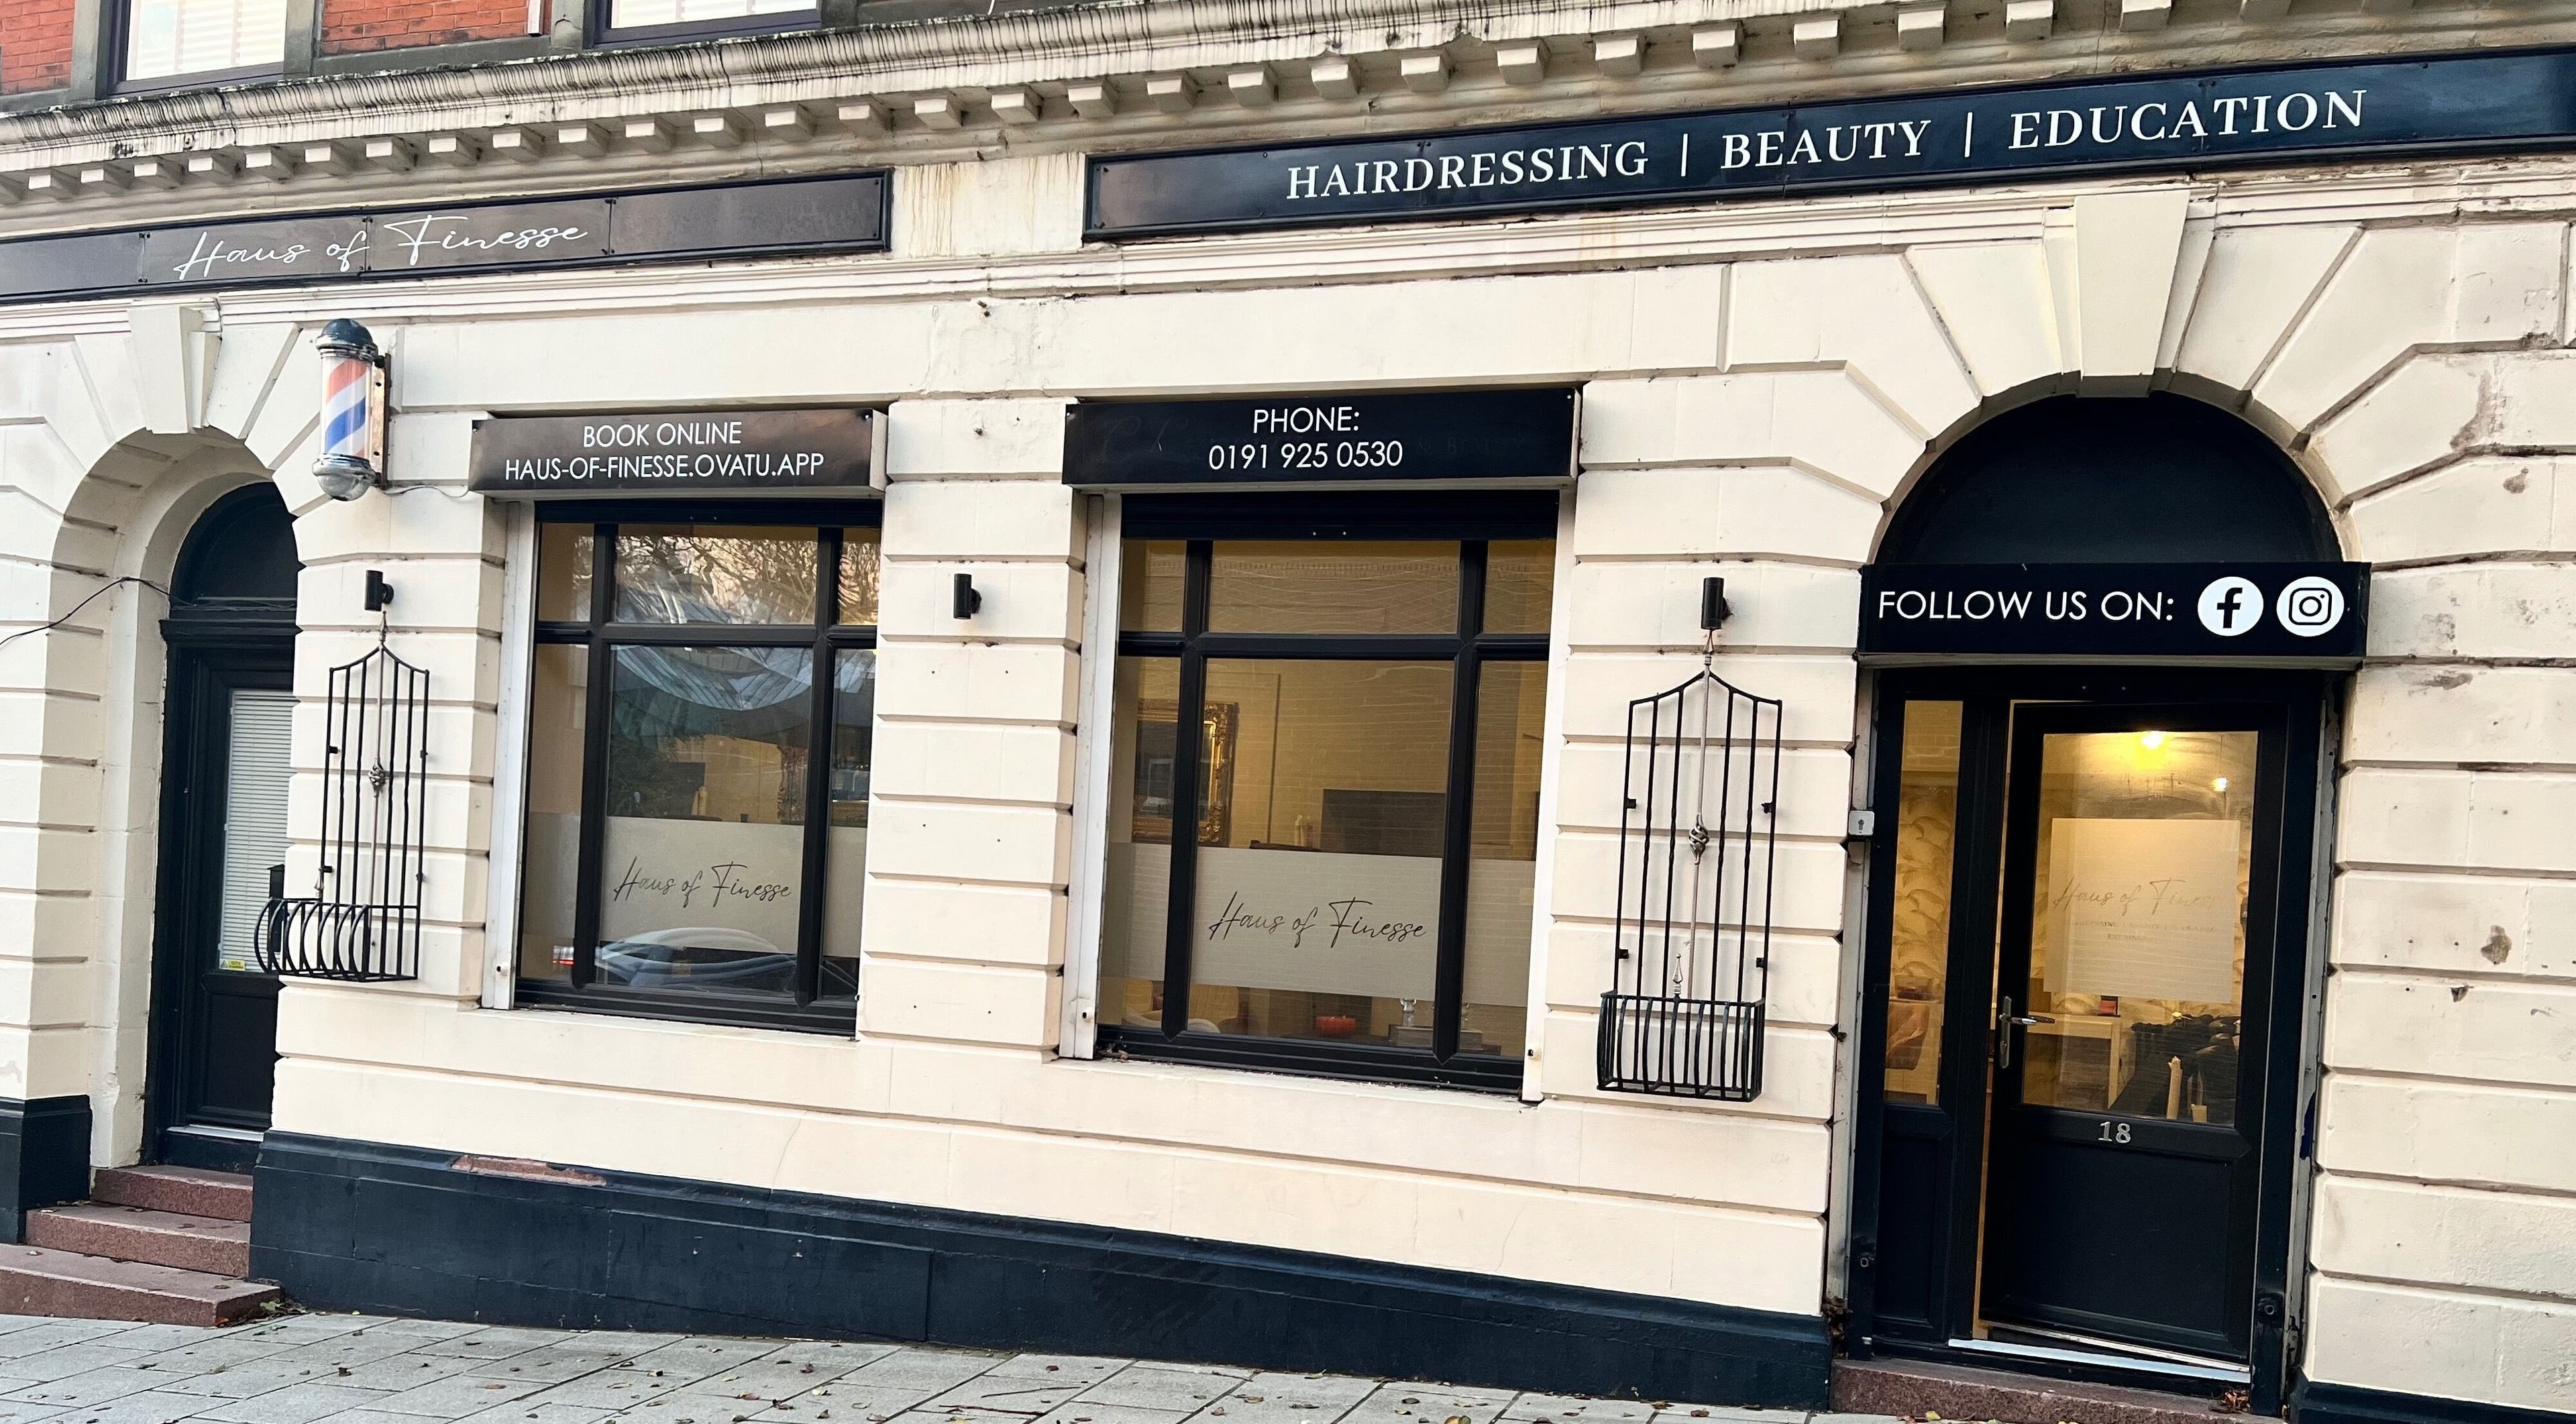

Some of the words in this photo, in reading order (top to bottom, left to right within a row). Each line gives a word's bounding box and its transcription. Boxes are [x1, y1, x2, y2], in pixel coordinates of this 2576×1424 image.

[1286, 140, 1648, 200] HAIRDRESSING
[1720, 119, 1932, 169] BEAUTY
[2008, 89, 2367, 150] EDUCATION
[172, 231, 311, 280] Haus
[326, 230, 368, 272] of
[383, 214, 588, 266] Finesse
[583, 423, 649, 447] BOOK
[656, 421, 742, 445] ONLINE
[1253, 406, 1360, 434] PHONE:
[504, 453, 824, 480] HAUS-OF-FINESSE.OVATU.APP
[1209, 444, 1267, 470] 0191
[1281, 443, 1328, 468] 925
[1336, 440, 1403, 468] 0530
[1878, 590, 2033, 620] FOLLOW
[2045, 591, 2087, 620] US
[2101, 591, 2174, 621] ON:
[614, 856, 676, 901] Haus
[682, 870, 703, 908] of
[711, 861, 792, 908] Finesse
[1209, 891, 1285, 940] Haus
[1292, 907, 1318, 948] of
[1328, 897, 1427, 948] Finesse
[2098, 1121, 2131, 1144] 18
